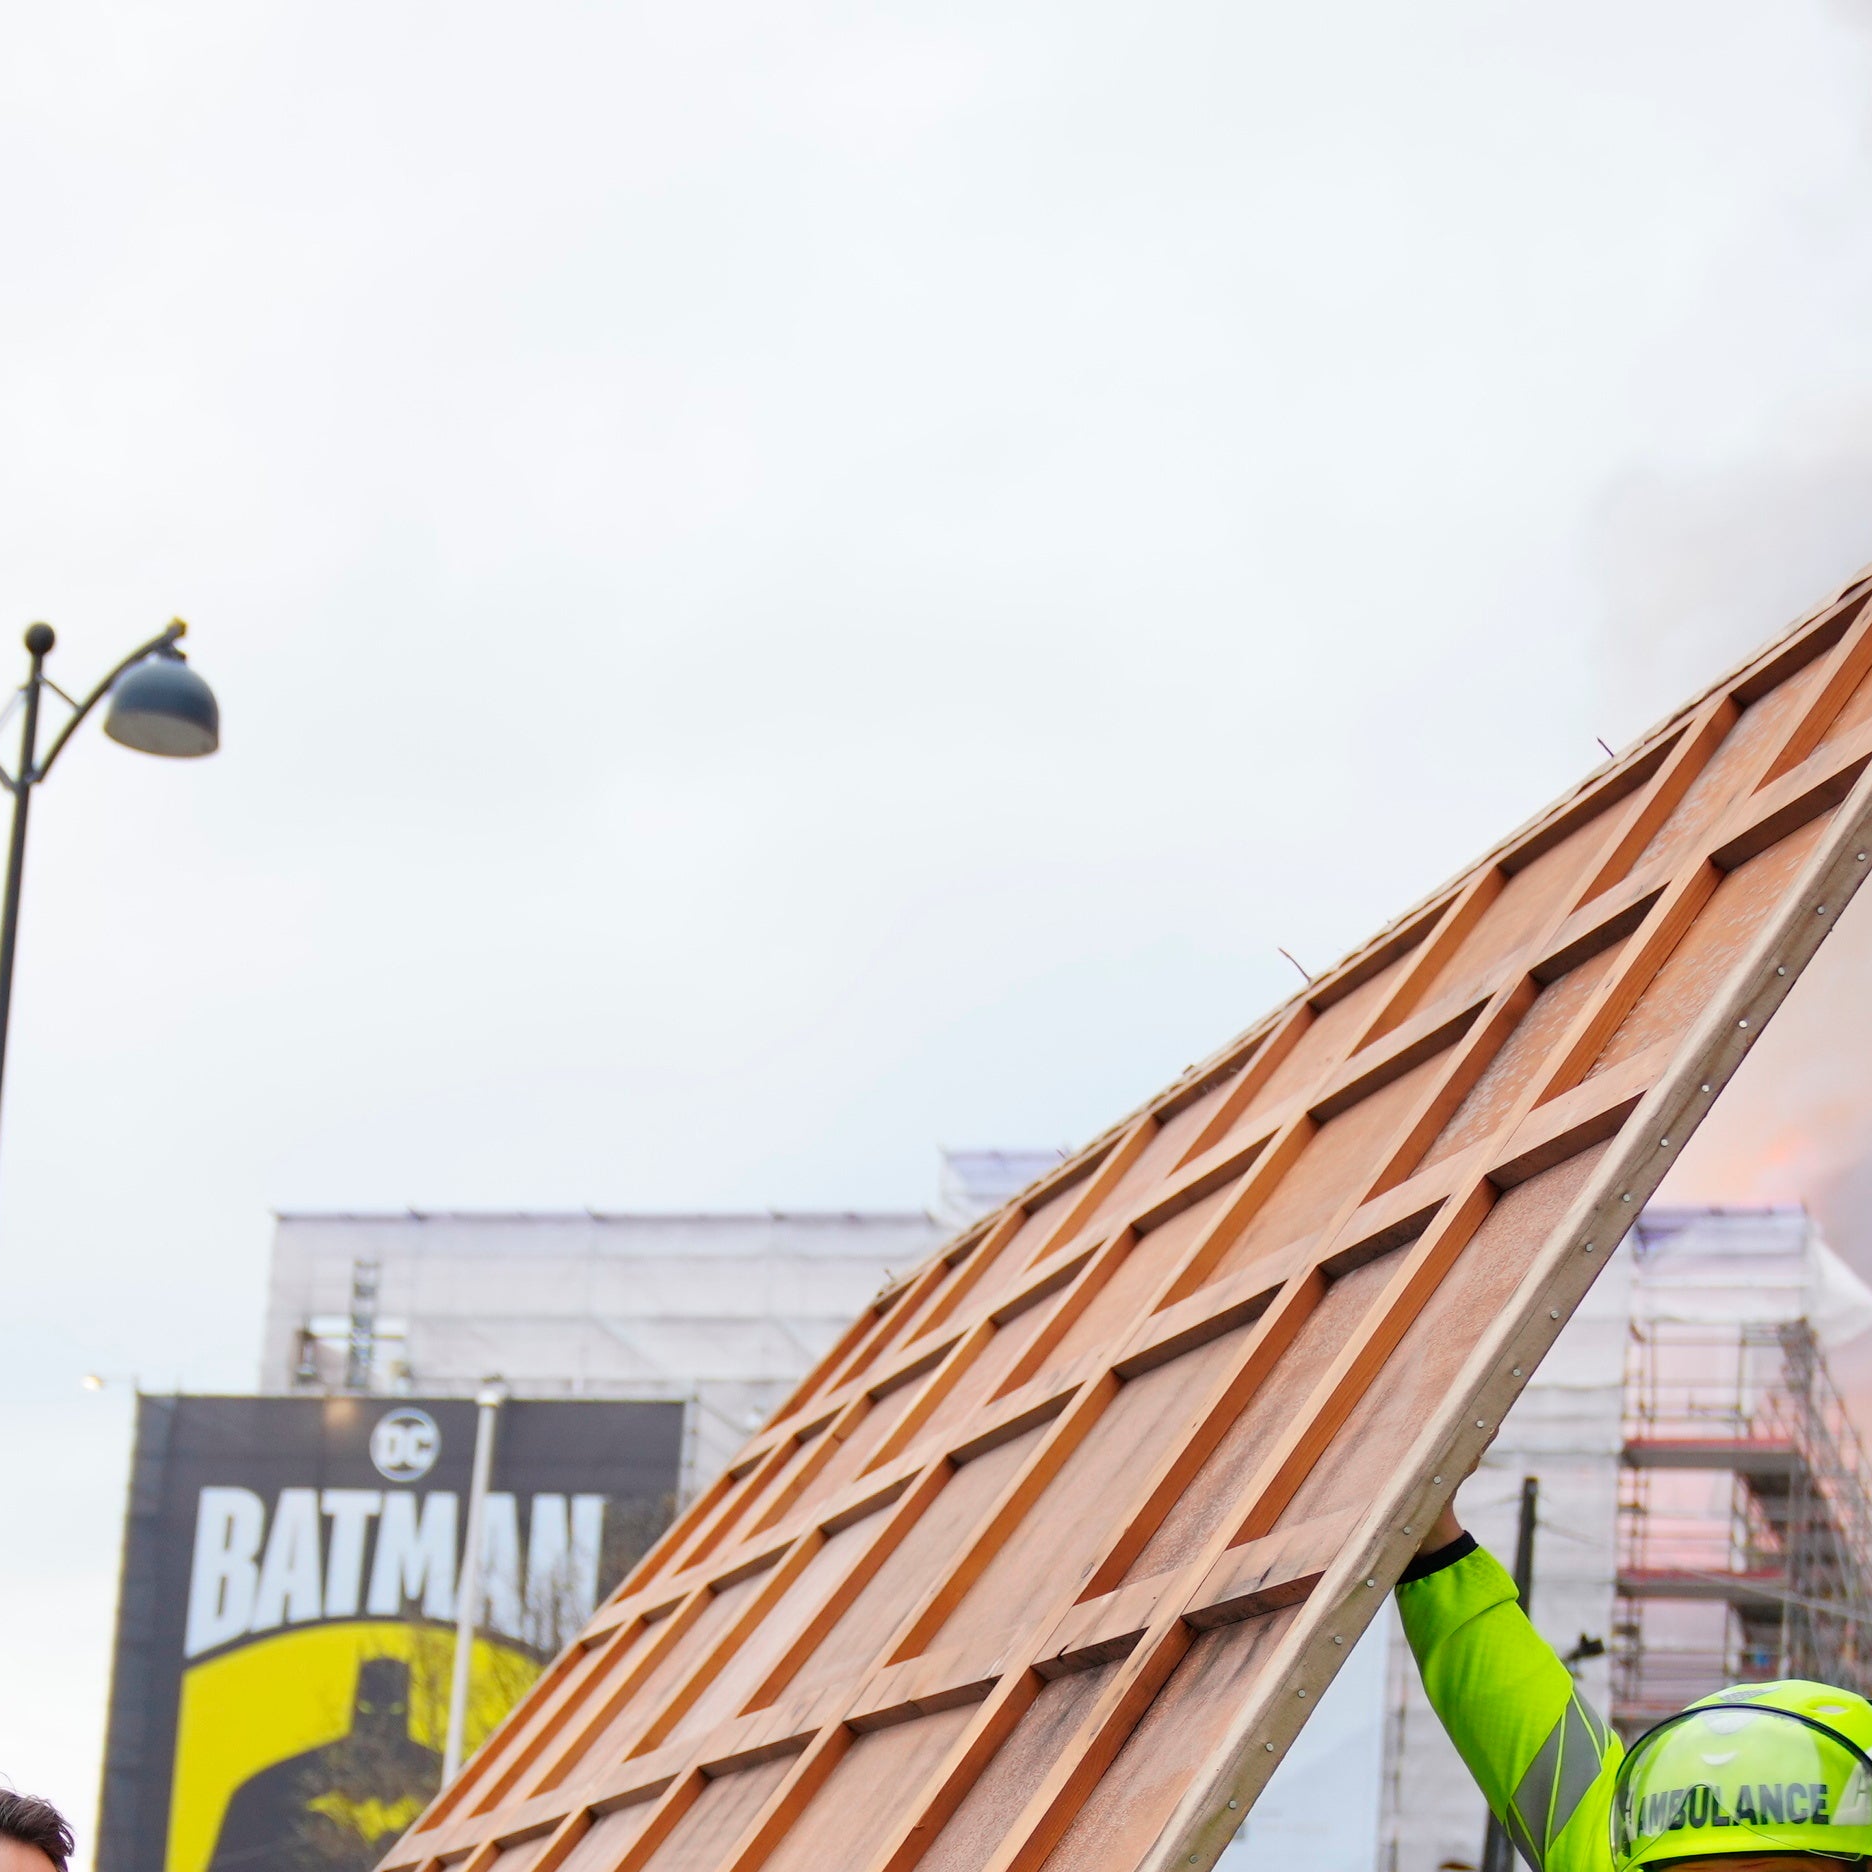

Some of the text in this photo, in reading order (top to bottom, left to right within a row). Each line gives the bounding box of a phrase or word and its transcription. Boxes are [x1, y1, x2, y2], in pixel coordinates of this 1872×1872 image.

[370, 1421, 440, 1470] DC
[183, 1486, 607, 1658] BATMAN
[1637, 1782, 1830, 1836] AMBULANCE
